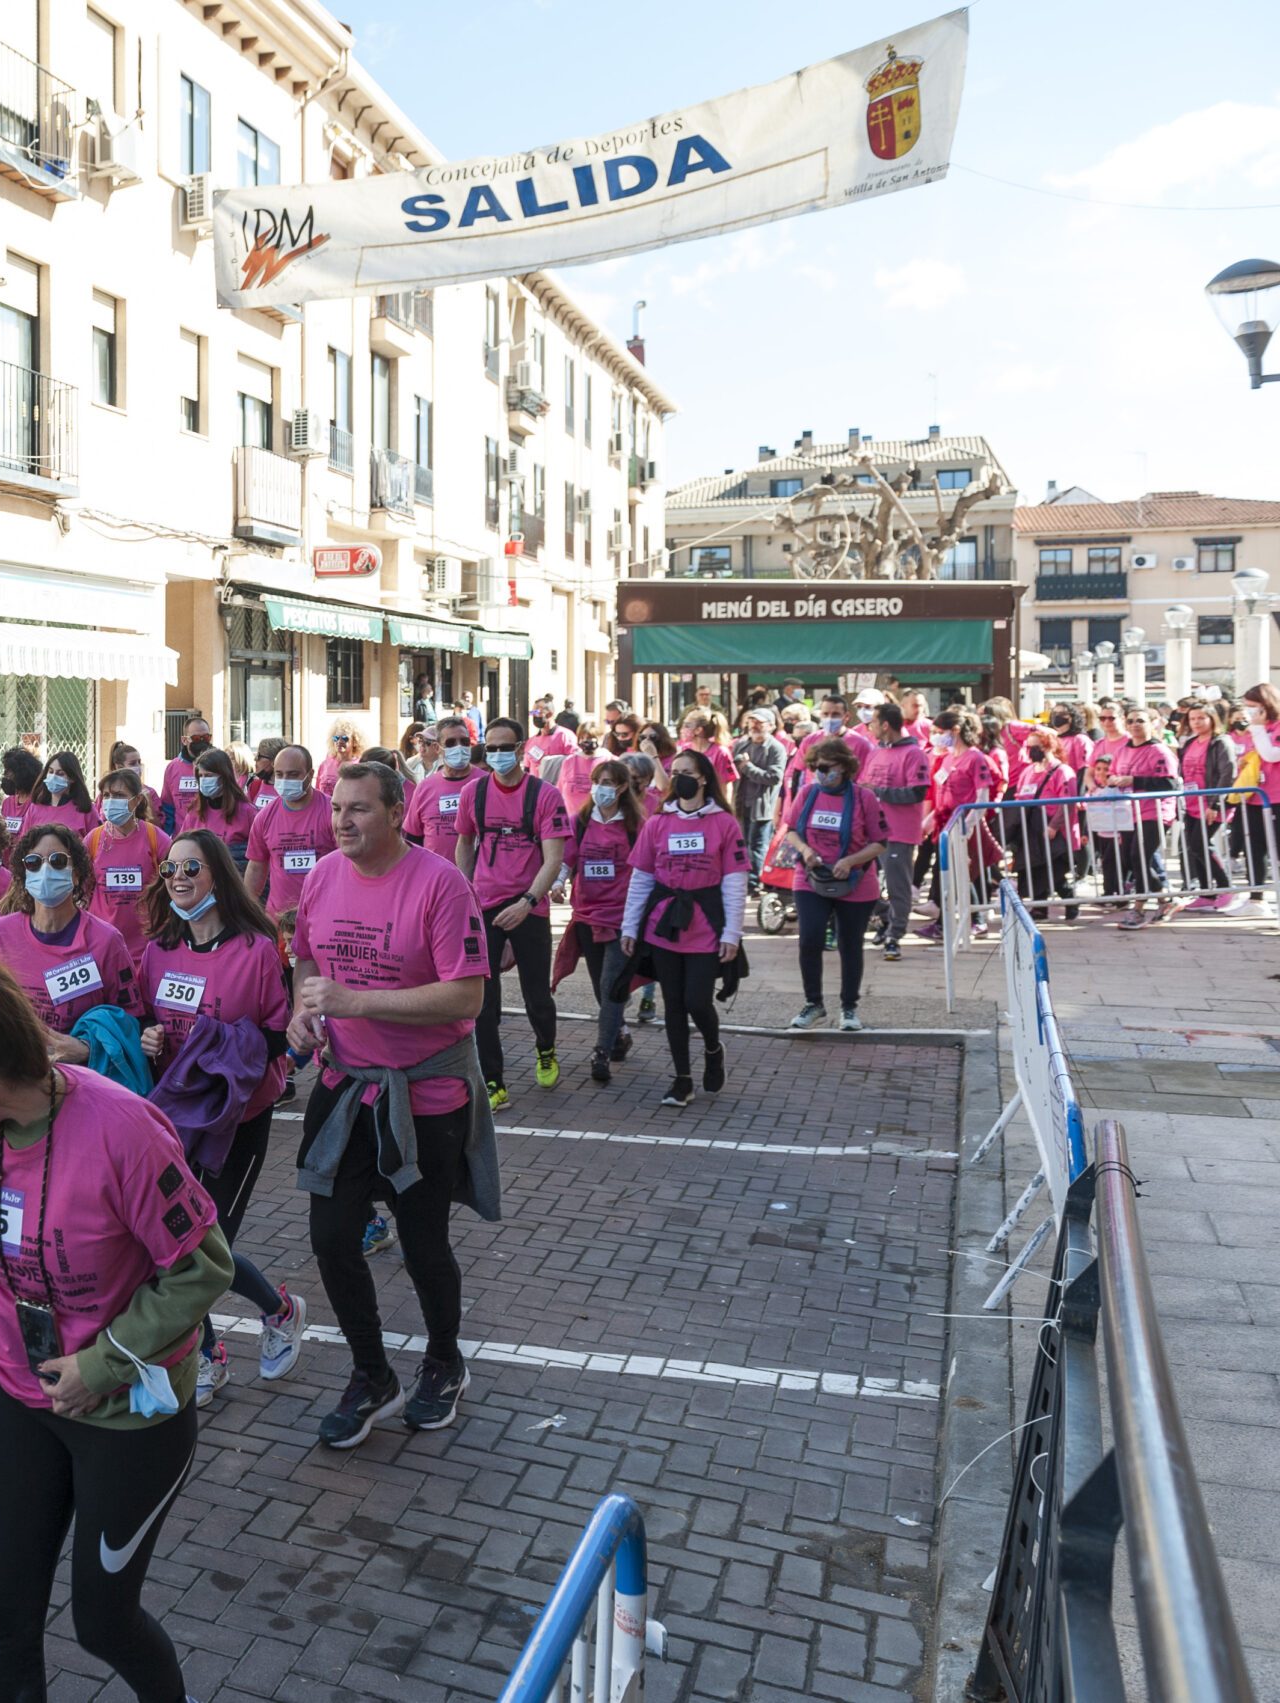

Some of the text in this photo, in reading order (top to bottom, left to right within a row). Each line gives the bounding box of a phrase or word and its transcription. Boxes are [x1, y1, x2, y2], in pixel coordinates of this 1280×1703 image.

[546, 145, 574, 166] de
[585, 116, 684, 157] Deportes
[400, 134, 732, 233] SALIDA
[242, 205, 314, 253] IDM
[702, 594, 903, 619] MENÚ DEL DÍA CASERO
[818, 815, 837, 825] 060
[676, 839, 698, 849] 136
[290, 857, 310, 867] 137
[590, 866, 609, 875] 188
[113, 873, 136, 884] 139
[336, 943, 378, 962] MUJER
[57, 968, 91, 992] 349
[165, 982, 196, 1002] 350
